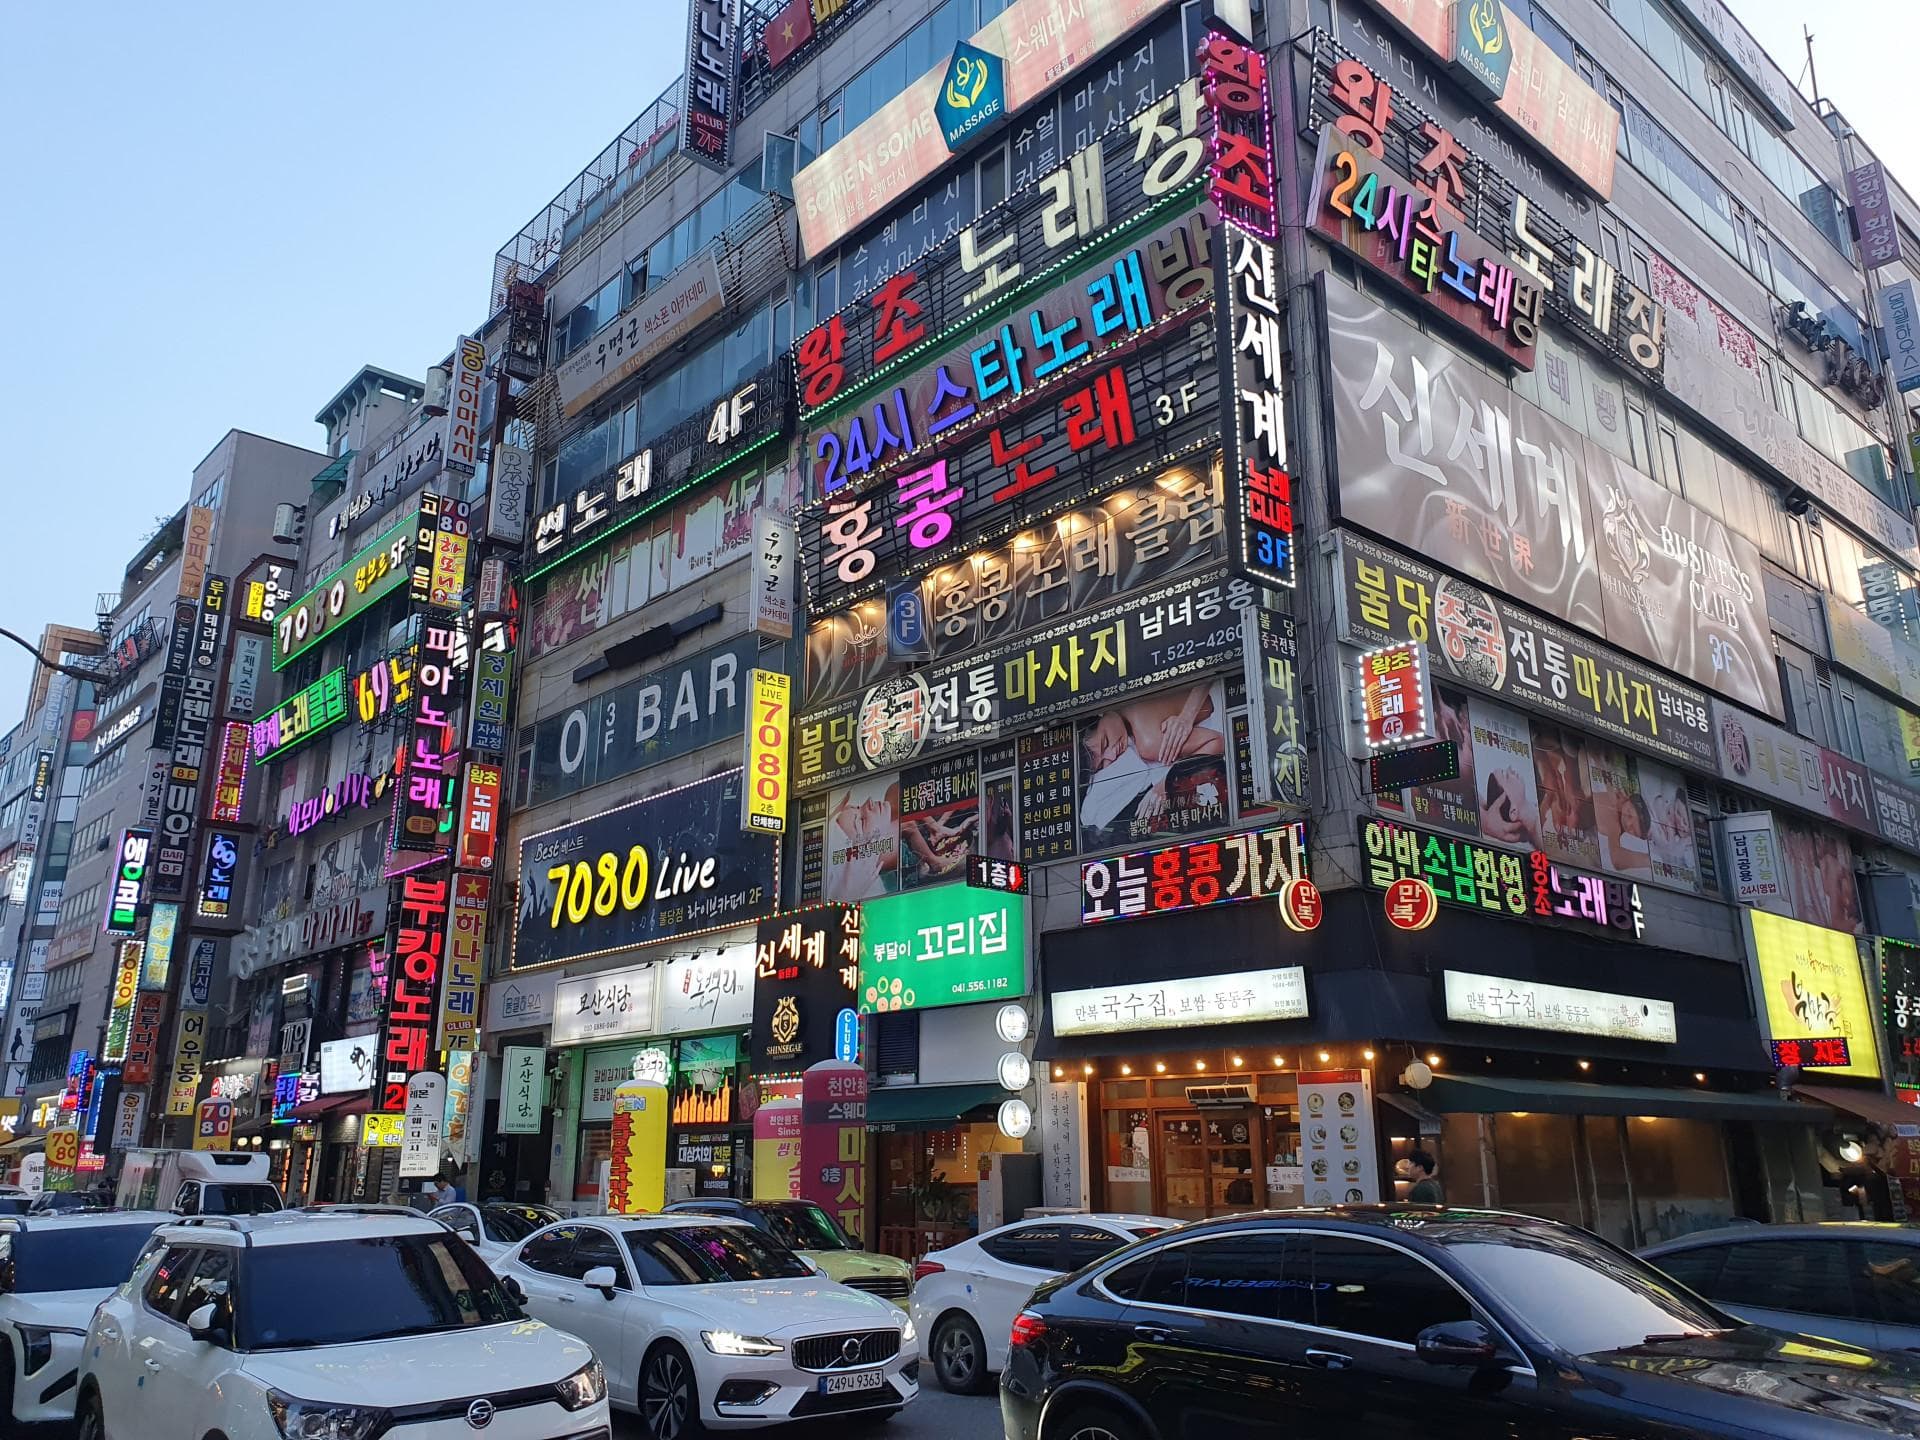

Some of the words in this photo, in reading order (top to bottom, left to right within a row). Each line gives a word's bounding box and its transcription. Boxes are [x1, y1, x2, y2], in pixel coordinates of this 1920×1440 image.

[1460, 46, 1502, 89] MASSAGE
[696, 112, 724, 131] CLUB
[697, 128, 722, 153] 7F
[949, 98, 1001, 143] MASSAGE
[1201, 39, 1272, 209] 왕초
[1331, 151, 1413, 260] 24시
[799, 270, 926, 407] 왕초
[960, 76, 1206, 306] 노래장
[594, 317, 642, 376] 우명균
[669, 277, 708, 315] 아카데미
[1232, 236, 1288, 470] 신세계
[706, 382, 758, 446] 4F
[815, 387, 915, 494] 24시
[1360, 342, 1585, 563] 신세계
[821, 459, 966, 584] 홍콩
[988, 365, 1137, 503] 노래
[1155, 380, 1200, 427] 3F
[1247, 457, 1290, 505] 노래
[535, 448, 653, 554] 썬노래
[1248, 490, 1293, 533] CLUB
[761, 532, 785, 592] 우명균
[1256, 530, 1289, 570] 3F
[1659, 524, 1755, 606] BUSINESS
[261, 564, 282, 622] 7080
[276, 588, 293, 606] 5F
[278, 578, 346, 656] 7080
[390, 534, 408, 570] 5F
[1139, 577, 1255, 643] 남녀공용
[1688, 580, 1741, 633] CLUB
[198, 613, 220, 654] 테라피
[758, 607, 791, 623] 아카데미
[1355, 556, 1431, 645] 불당
[1508, 624, 1658, 736] 전통마사지
[1707, 633, 1733, 677] 3F
[233, 695, 254, 709] PC
[478, 655, 507, 720] 정체원
[635, 652, 738, 744] BAR
[756, 672, 787, 690] 베스트
[760, 690, 783, 700] LIVE
[1379, 675, 1405, 716] 노래
[476, 722, 504, 735] 자세
[799, 713, 857, 774] 불당
[861, 688, 923, 757] 중국
[1267, 658, 1304, 796] 마사지
[1382, 718, 1402, 738] 4F
[1657, 688, 1709, 733] 남녀공용
[474, 734, 503, 749] 교정
[755, 699, 783, 801] 7080
[1023, 751, 1070, 773] 스포츠전신
[332, 772, 373, 814] LIVE
[407, 738, 444, 810] 노래
[469, 767, 498, 787] 왕초
[162, 786, 196, 846] 미우
[216, 807, 236, 817] 4F
[470, 786, 493, 833] 노래
[752, 815, 783, 831] 단체환영
[760, 802, 776, 814] 2층
[162, 850, 183, 860] BAR
[534, 838, 561, 862] Best
[560, 834, 585, 856] 베스트
[1733, 835, 1753, 883] 남녀공용
[207, 868, 231, 900] 노래
[547, 845, 650, 930] 7080
[655, 852, 717, 901] Live
[977, 861, 1008, 888] 1층
[1082, 857, 1148, 921] 오늘
[1150, 842, 1222, 910] 홍콩
[1225, 825, 1304, 897] 가자
[1472, 846, 1529, 916] 환영
[1740, 882, 1778, 896] 24시영업
[456, 895, 487, 910] 베트남
[659, 908, 685, 927] 불당점
[1297, 884, 1316, 923] 만복
[1389, 882, 1420, 923] 만복
[1550, 864, 1631, 930] 노래방
[301, 897, 361, 951] 마사지
[873, 940, 911, 963] 봉달이
[916, 907, 1008, 962] 꼬리집
[120, 942, 139, 1000] 7080
[446, 912, 484, 1016] 하나노래
[755, 922, 826, 979] 신세계
[839, 909, 862, 992] 신세계
[383, 876, 447, 1072] 부킹노래
[951, 977, 1009, 994] 041.556.1182
[576, 984, 632, 1016] 모산식당
[1074, 1004, 1099, 1022] 만복
[1101, 989, 1168, 1021] 국수집
[1466, 992, 1487, 1011] 만복
[1487, 986, 1537, 1020] 국수집
[446, 1021, 472, 1032] CLUB
[447, 1034, 469, 1048] 7F
[175, 1016, 204, 1083] 어우동
[766, 1044, 803, 1057] SHINSEGAE
[172, 1086, 195, 1098] 노래
[172, 1101, 189, 1113] 1F
[408, 1088, 430, 1100] 레몬
[517, 1056, 536, 1119] 모산식당
[777, 1126, 801, 1137] Since
[821, 1167, 841, 1184] 3층
[856, 1372, 882, 1388] 9363
